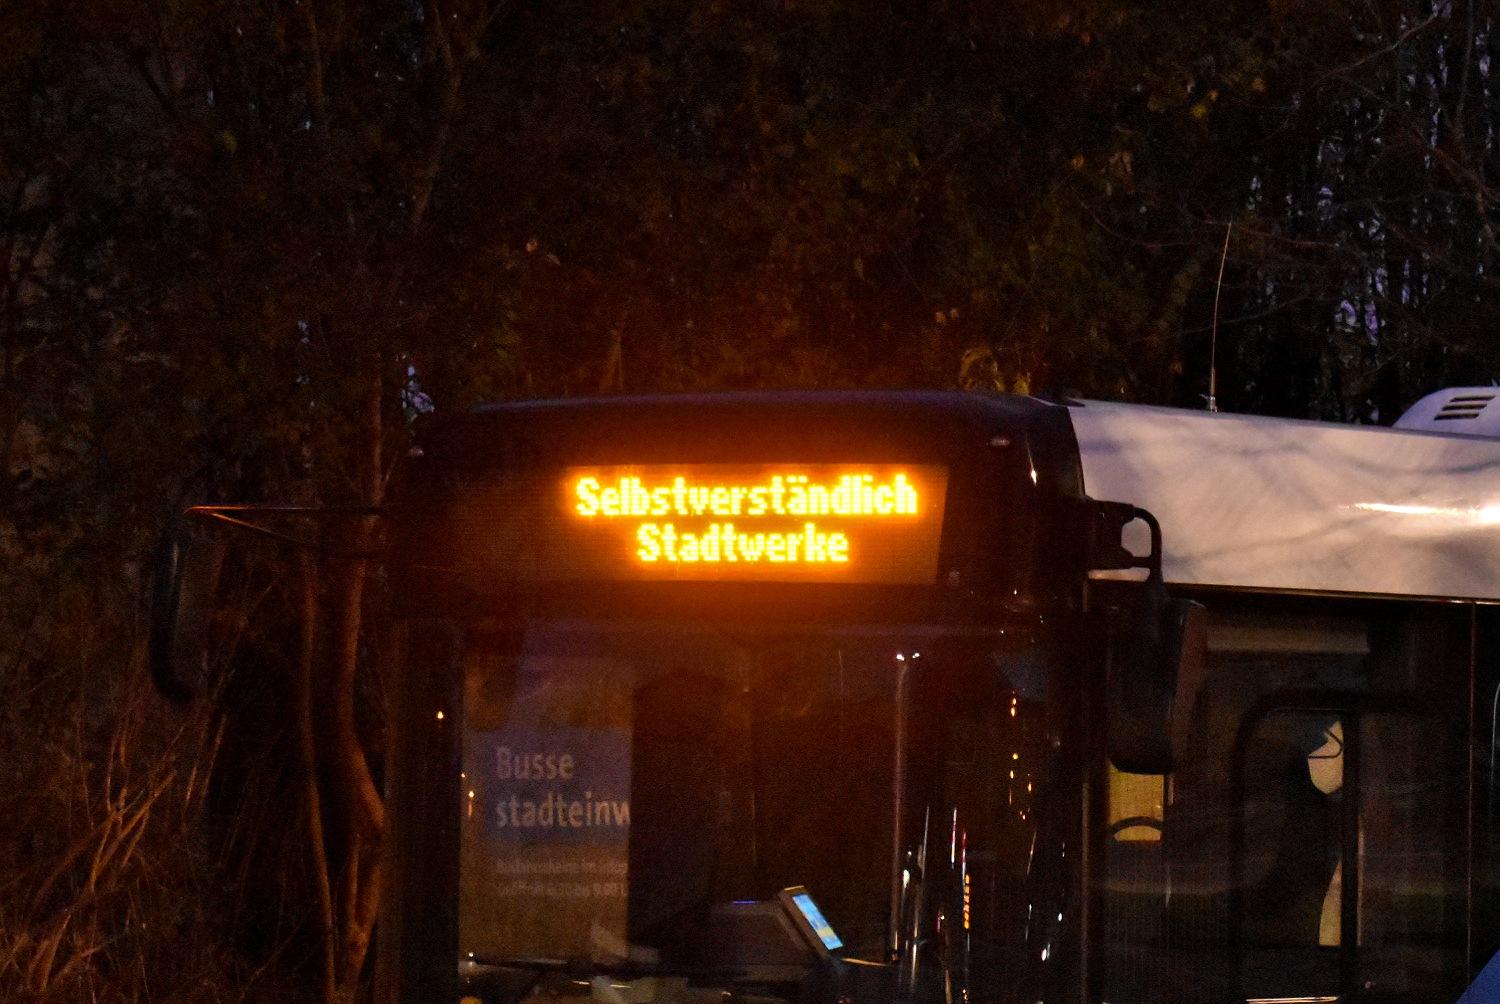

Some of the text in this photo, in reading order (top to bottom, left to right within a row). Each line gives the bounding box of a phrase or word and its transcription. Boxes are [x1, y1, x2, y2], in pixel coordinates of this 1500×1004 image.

[576, 473, 918, 516] Selbstverständlich
[636, 522, 849, 563] Stadtwerke
[497, 747, 575, 780] Busse
